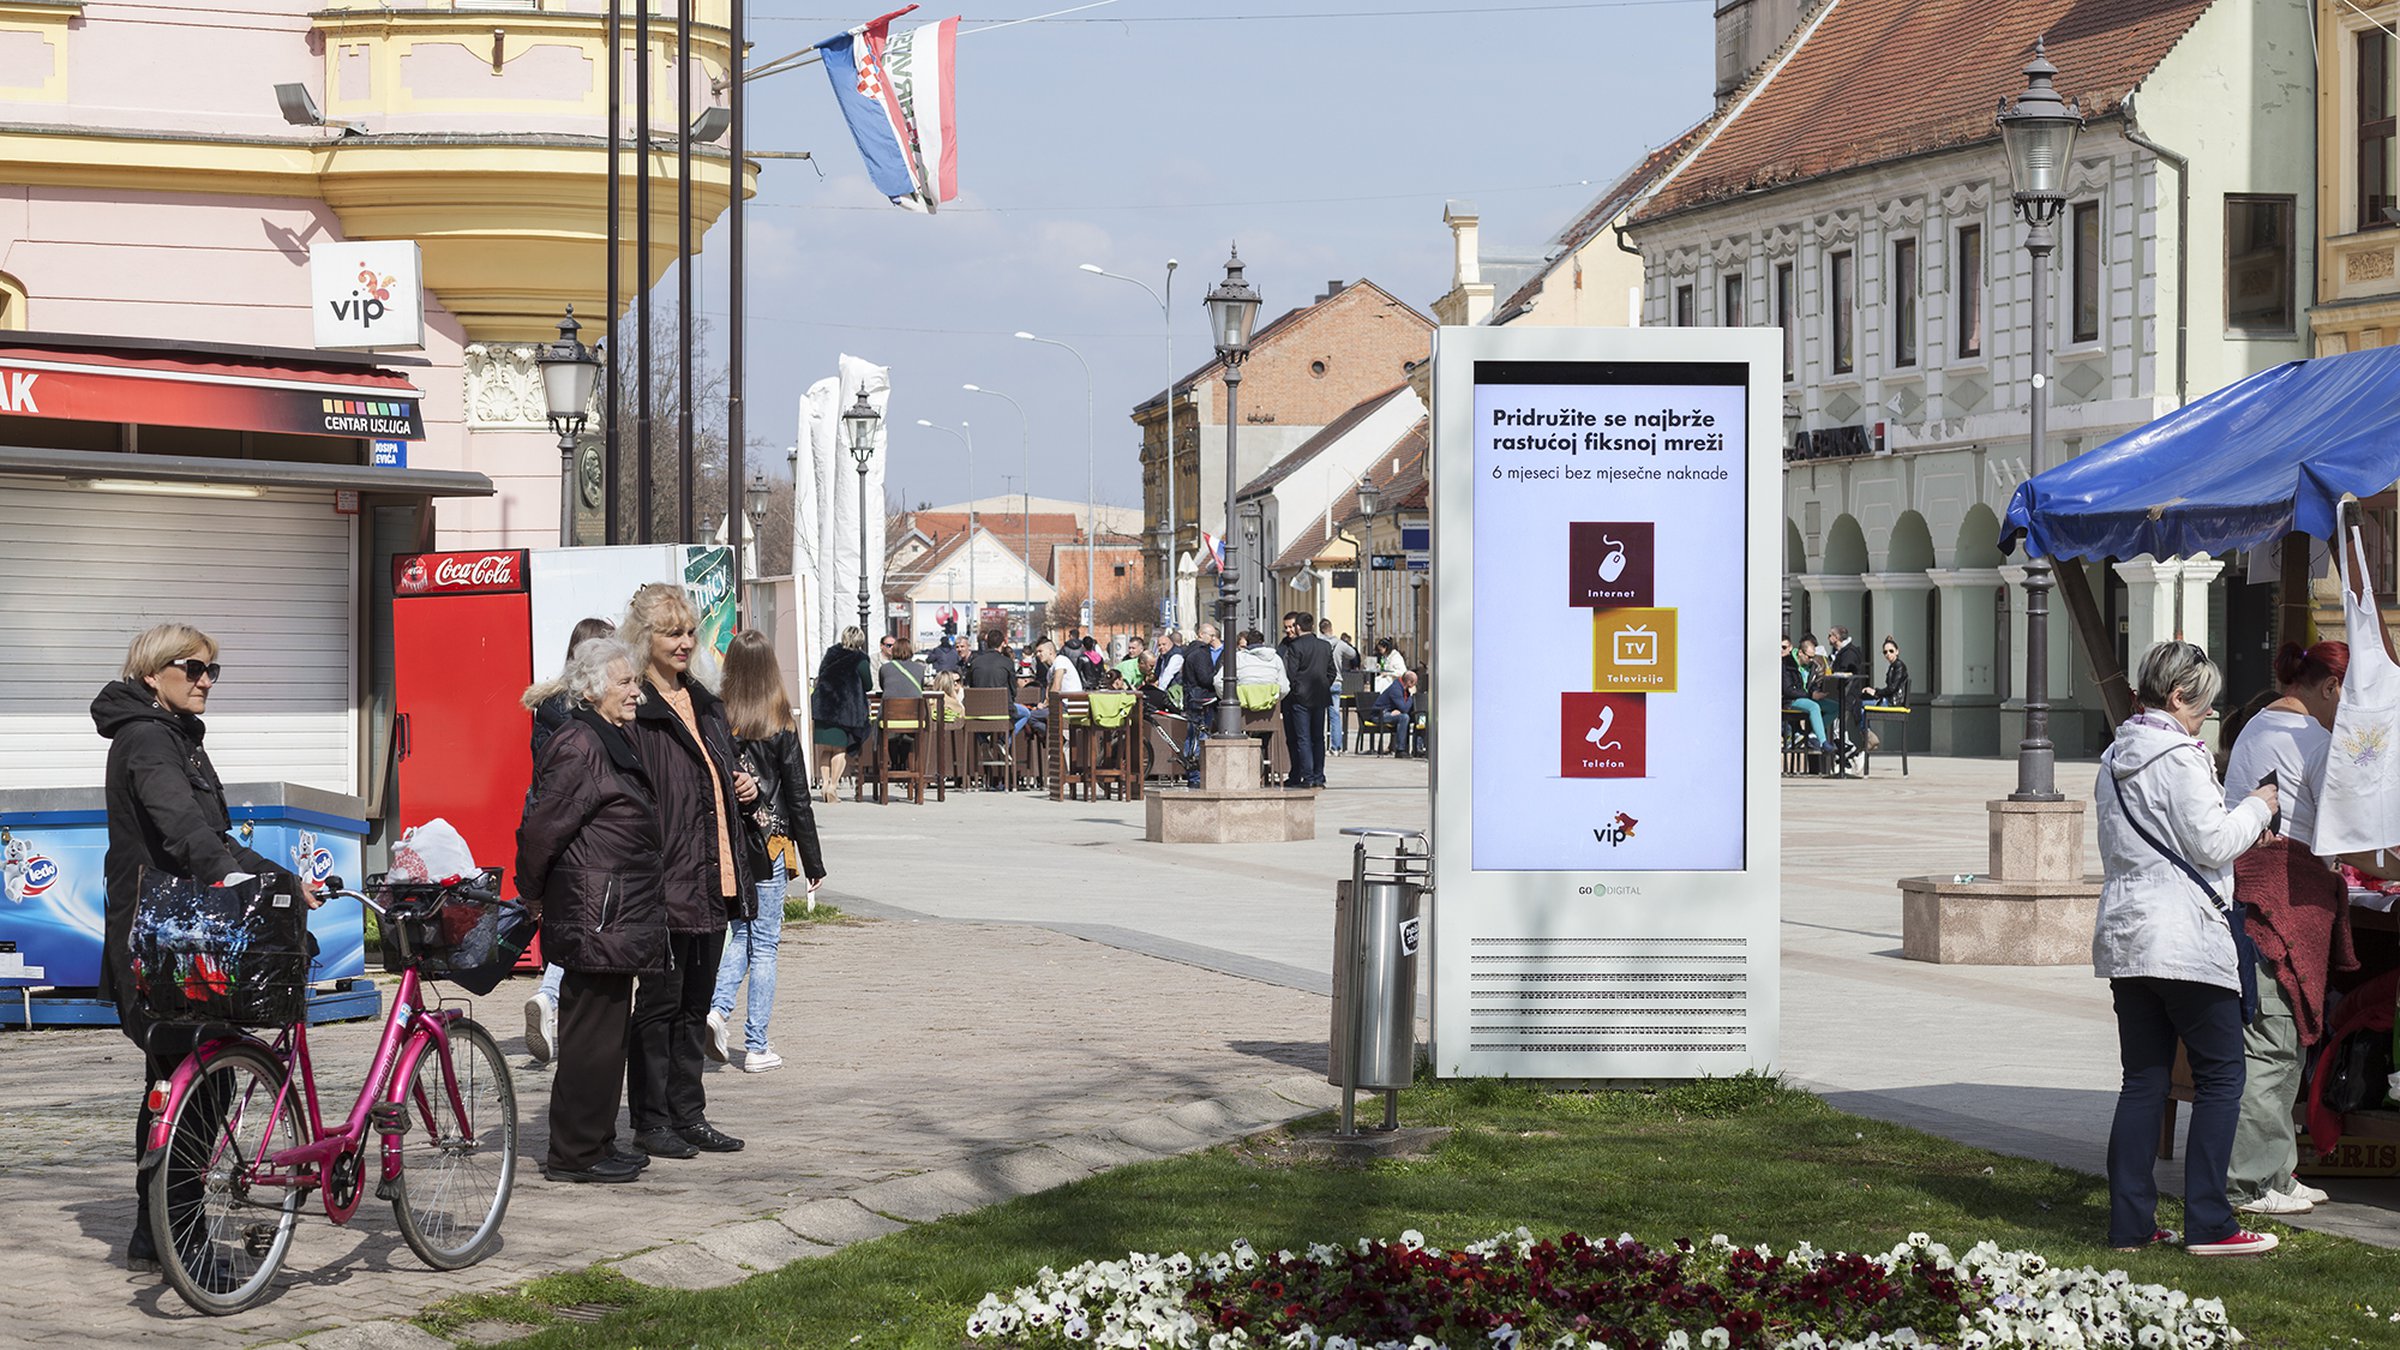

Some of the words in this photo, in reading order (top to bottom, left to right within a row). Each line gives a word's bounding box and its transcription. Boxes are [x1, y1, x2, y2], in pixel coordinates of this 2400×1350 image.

[330, 290, 385, 328] vip
[324, 416, 368, 432] CENTAR
[370, 418, 412, 435] USLUGA
[1492, 408, 1597, 427] Pridružite
[1603, 412, 1627, 427] se
[1634, 408, 1716, 432] najbrže
[1492, 432, 1578, 455] rastućoj
[1584, 432, 1656, 455] fiksnoj
[1664, 432, 1724, 451] mreži
[1492, 465, 1502, 480] 6
[1507, 465, 1560, 483] mjeseci
[1565, 464, 1591, 480] bez
[1596, 465, 1662, 483] mjesečne
[1666, 464, 1729, 480] naknade
[435, 555, 515, 586] Coca-Cola
[1588, 589, 1635, 598] Internet
[1624, 642, 1646, 655] TV
[1606, 674, 1664, 685] Televizija
[1582, 759, 1625, 768] Telefon
[1593, 822, 1627, 847] vip
[1578, 886, 1593, 895] GO
[1606, 886, 1642, 895] DIGITAL
